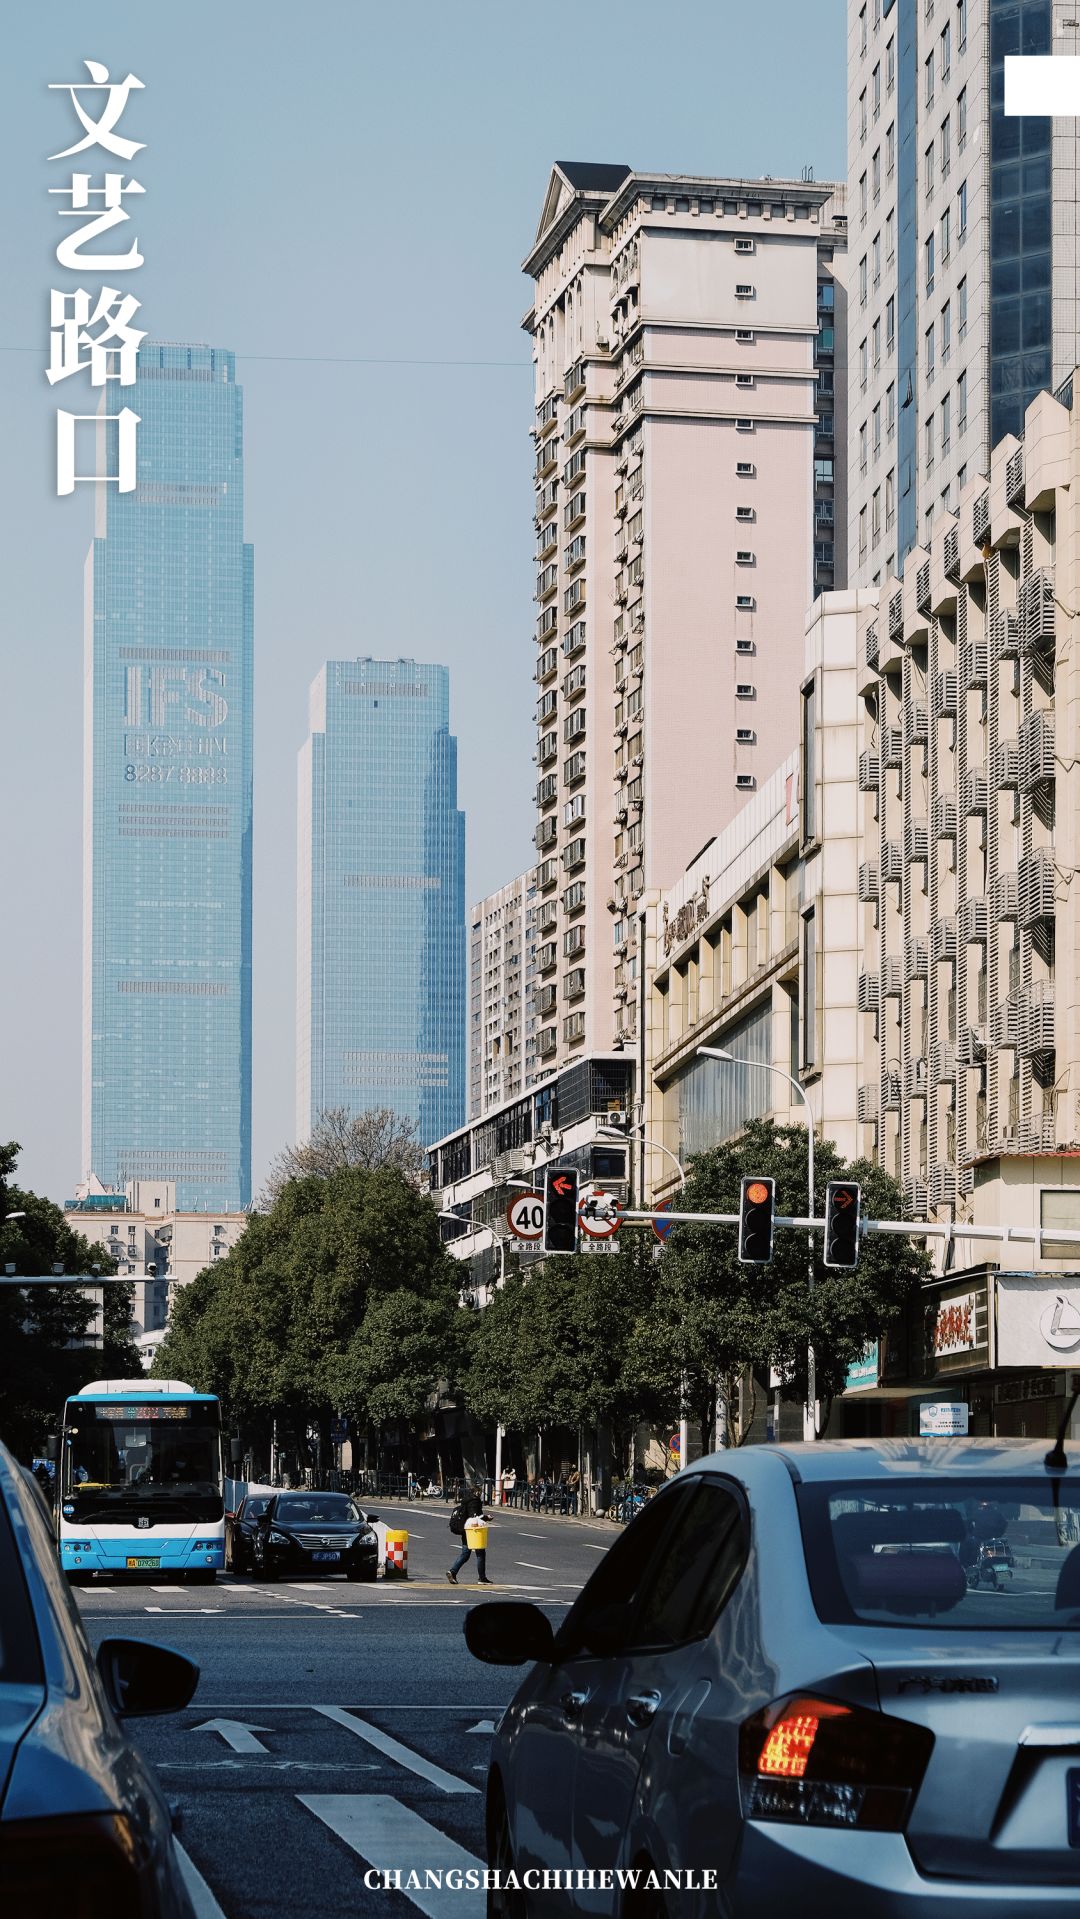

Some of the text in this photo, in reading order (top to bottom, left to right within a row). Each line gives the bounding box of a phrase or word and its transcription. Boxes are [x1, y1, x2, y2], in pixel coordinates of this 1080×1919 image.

[123, 666, 228, 728] IFS
[124, 764, 175, 782] 8287
[516, 1206, 544, 1229] 40
[517, 1242, 542, 1251] 全路段
[588, 1242, 612, 1251] 全路段
